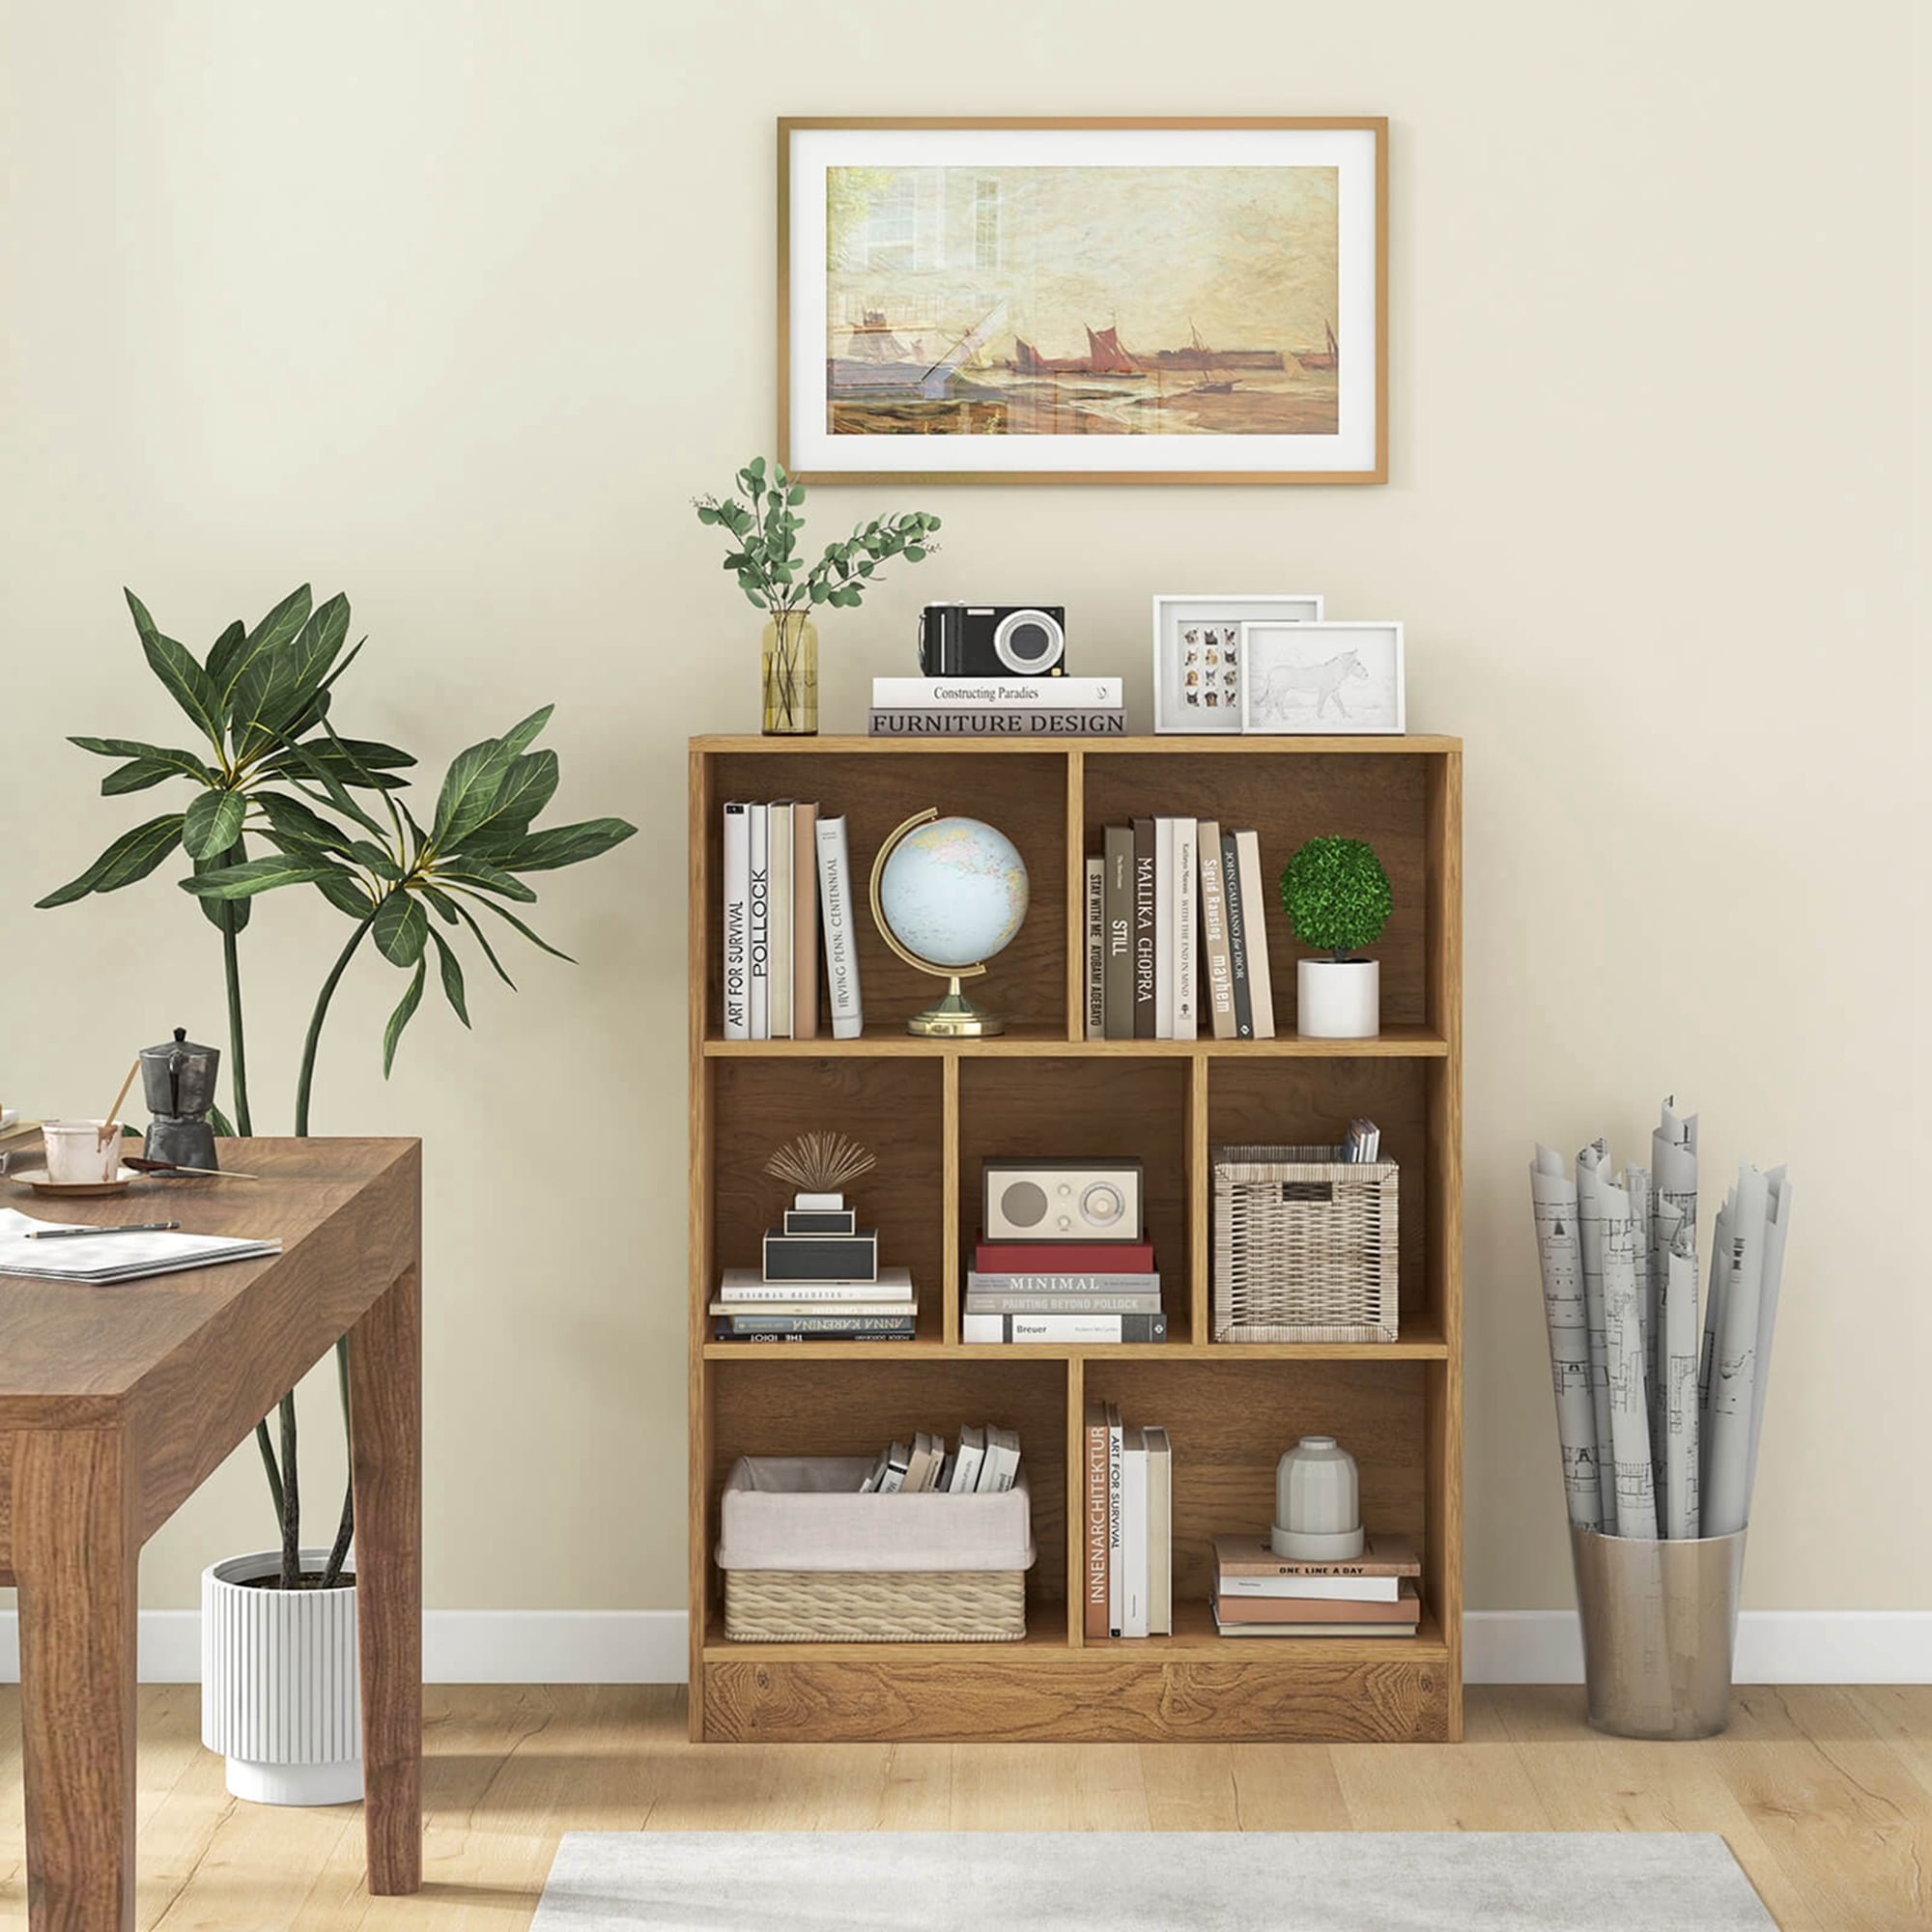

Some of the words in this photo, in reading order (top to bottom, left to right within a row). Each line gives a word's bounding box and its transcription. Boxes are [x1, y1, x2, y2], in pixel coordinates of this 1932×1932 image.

[934, 686, 996, 702] Constructing
[998, 686, 1039, 699] Paradies
[872, 715, 1023, 732] FURNITURE
[1031, 715, 1124, 732] DESIGN
[1202, 859, 1221, 893] Sigrid
[1224, 851, 1236, 881] JOHN
[826, 858, 843, 927] CENTENNIAL
[1090, 873, 1102, 897] STAY
[1137, 857, 1153, 928] MALLIKA
[752, 868, 767, 978] POLLOCK
[1090, 897, 1102, 922] WITH
[1207, 895, 1224, 942] Rausing
[1229, 881, 1241, 937] GALLIANO
[728, 900, 743, 964] SURVIVAL
[1090, 923, 1102, 938] ME
[1111, 920, 1128, 956] STILL
[1232, 937, 1243, 951] for
[831, 930, 846, 963] PENN:
[1090, 944, 1102, 984] AYOBAMI
[1137, 937, 1153, 1003] CHOPRA
[1181, 961, 1189, 971] IN
[1235, 951, 1245, 980] DIOR
[728, 968, 743, 996] FOR
[832, 965, 850, 1008] IRVING
[1211, 954, 1232, 1013] mayhem
[728, 1001, 743, 1027] ART
[1090, 986, 1102, 1026] ADEBAYO
[1009, 1277, 1100, 1290] MINIMAL
[1003, 1298, 1054, 1309] PAINTING
[1055, 1298, 1091, 1309] BEYOND
[1093, 1298, 1138, 1309] POLLOCK
[792, 1318, 860, 1331] KARENINA
[864, 1318, 904, 1330] ANNA
[1016, 1324, 1047, 1334] Breuer
[1110, 1435, 1121, 1458] ART
[1110, 1463, 1121, 1490] FOR
[1090, 1427, 1106, 1605] INNENARCHITEKTUR
[1110, 1492, 1121, 1549] SURVIVAL
